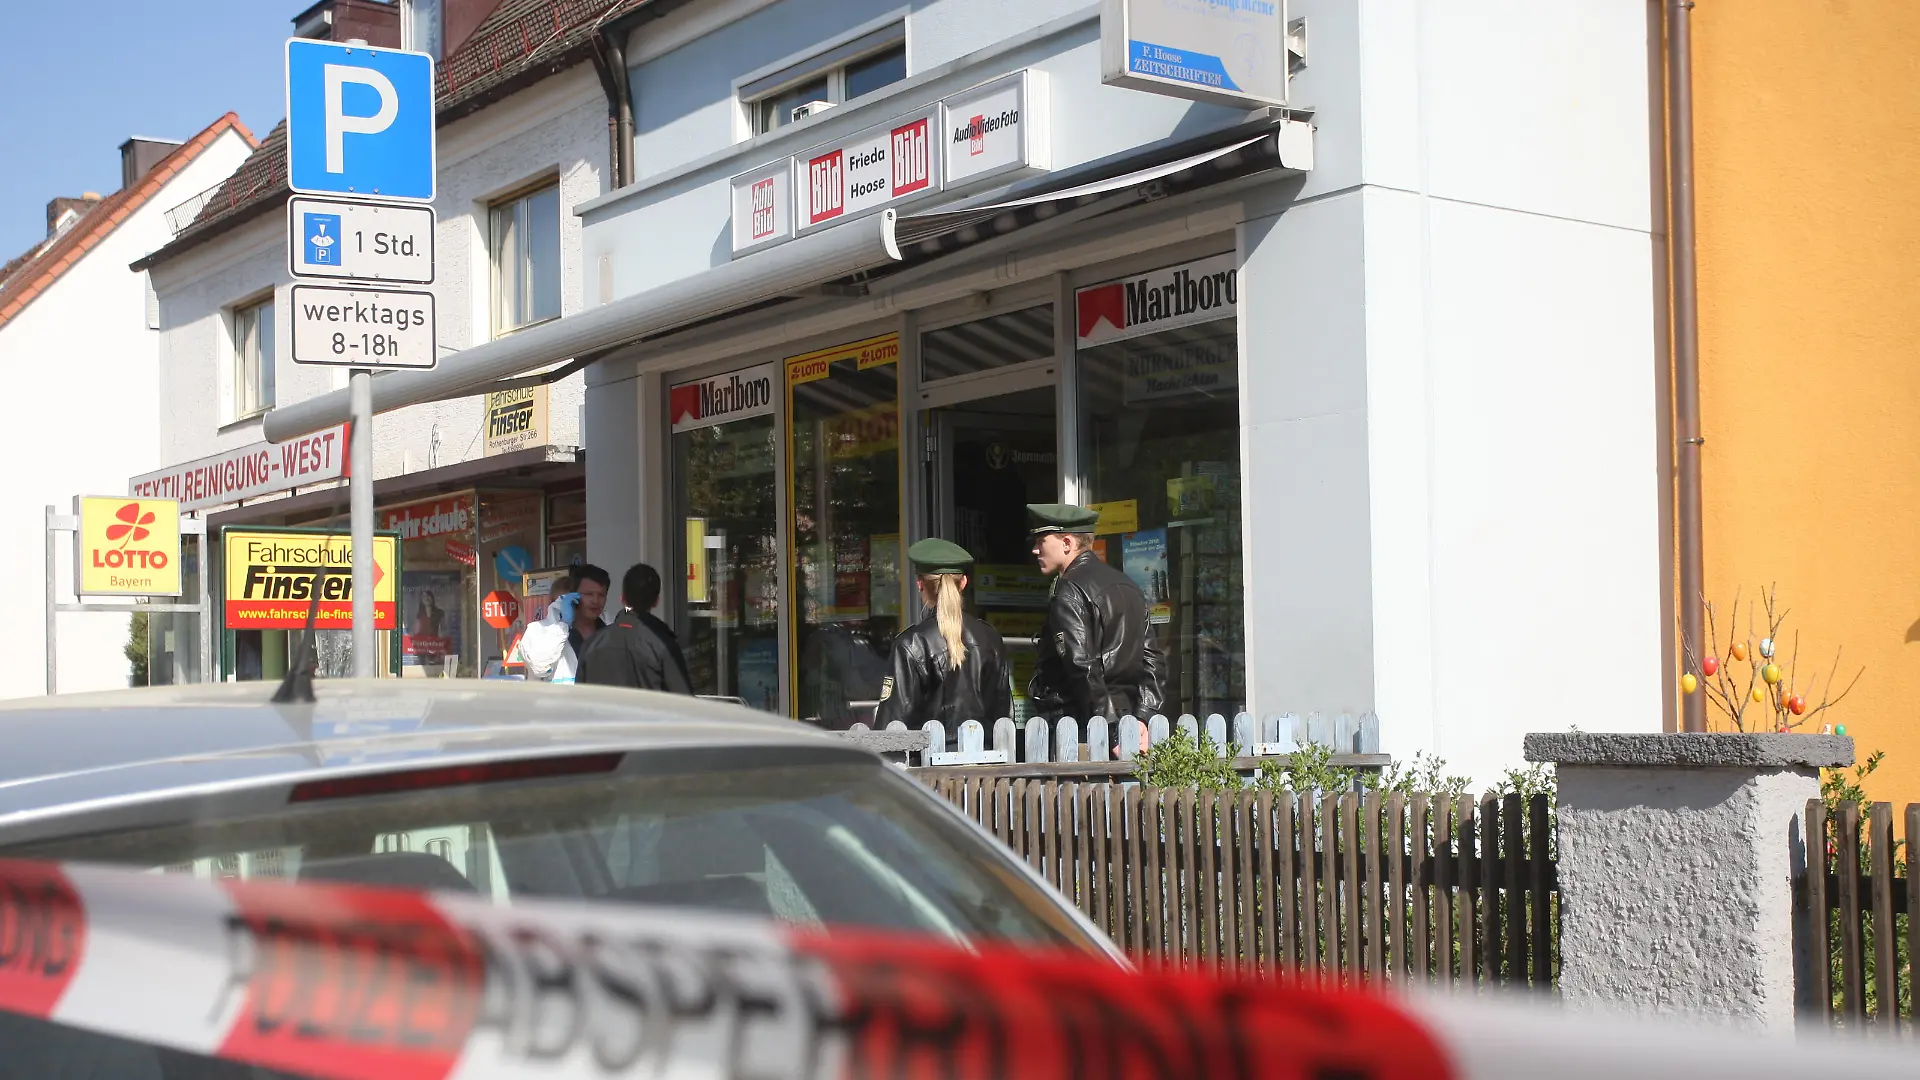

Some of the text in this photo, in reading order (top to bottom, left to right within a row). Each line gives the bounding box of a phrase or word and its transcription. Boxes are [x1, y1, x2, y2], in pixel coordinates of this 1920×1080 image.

[1153, 48, 1182, 64] Hoose
[1134, 58, 1223, 87] ZEITSCHRIFTEN
[324, 63, 399, 174] P
[849, 147, 886, 171] Frieda
[893, 124, 928, 189] Bild
[811, 157, 842, 216] Bild
[850, 177, 886, 199] Hoose
[754, 207, 773, 237] Bild
[355, 230, 421, 257] 1 Std.
[1125, 268, 1237, 327] Marlboro
[303, 300, 425, 331] werktags
[331, 332, 399, 357] 8-18h
[870, 344, 898, 362] LOTTO
[801, 360, 827, 378] LOTTO
[700, 374, 771, 418] Marlboro
[489, 408, 533, 439] Finster
[134, 432, 335, 503] TEXTILREINIGUNG-WEST
[93, 549, 168, 569] LOTTO
[110, 575, 152, 588] Bayern
[485, 601, 518, 618] STOP
